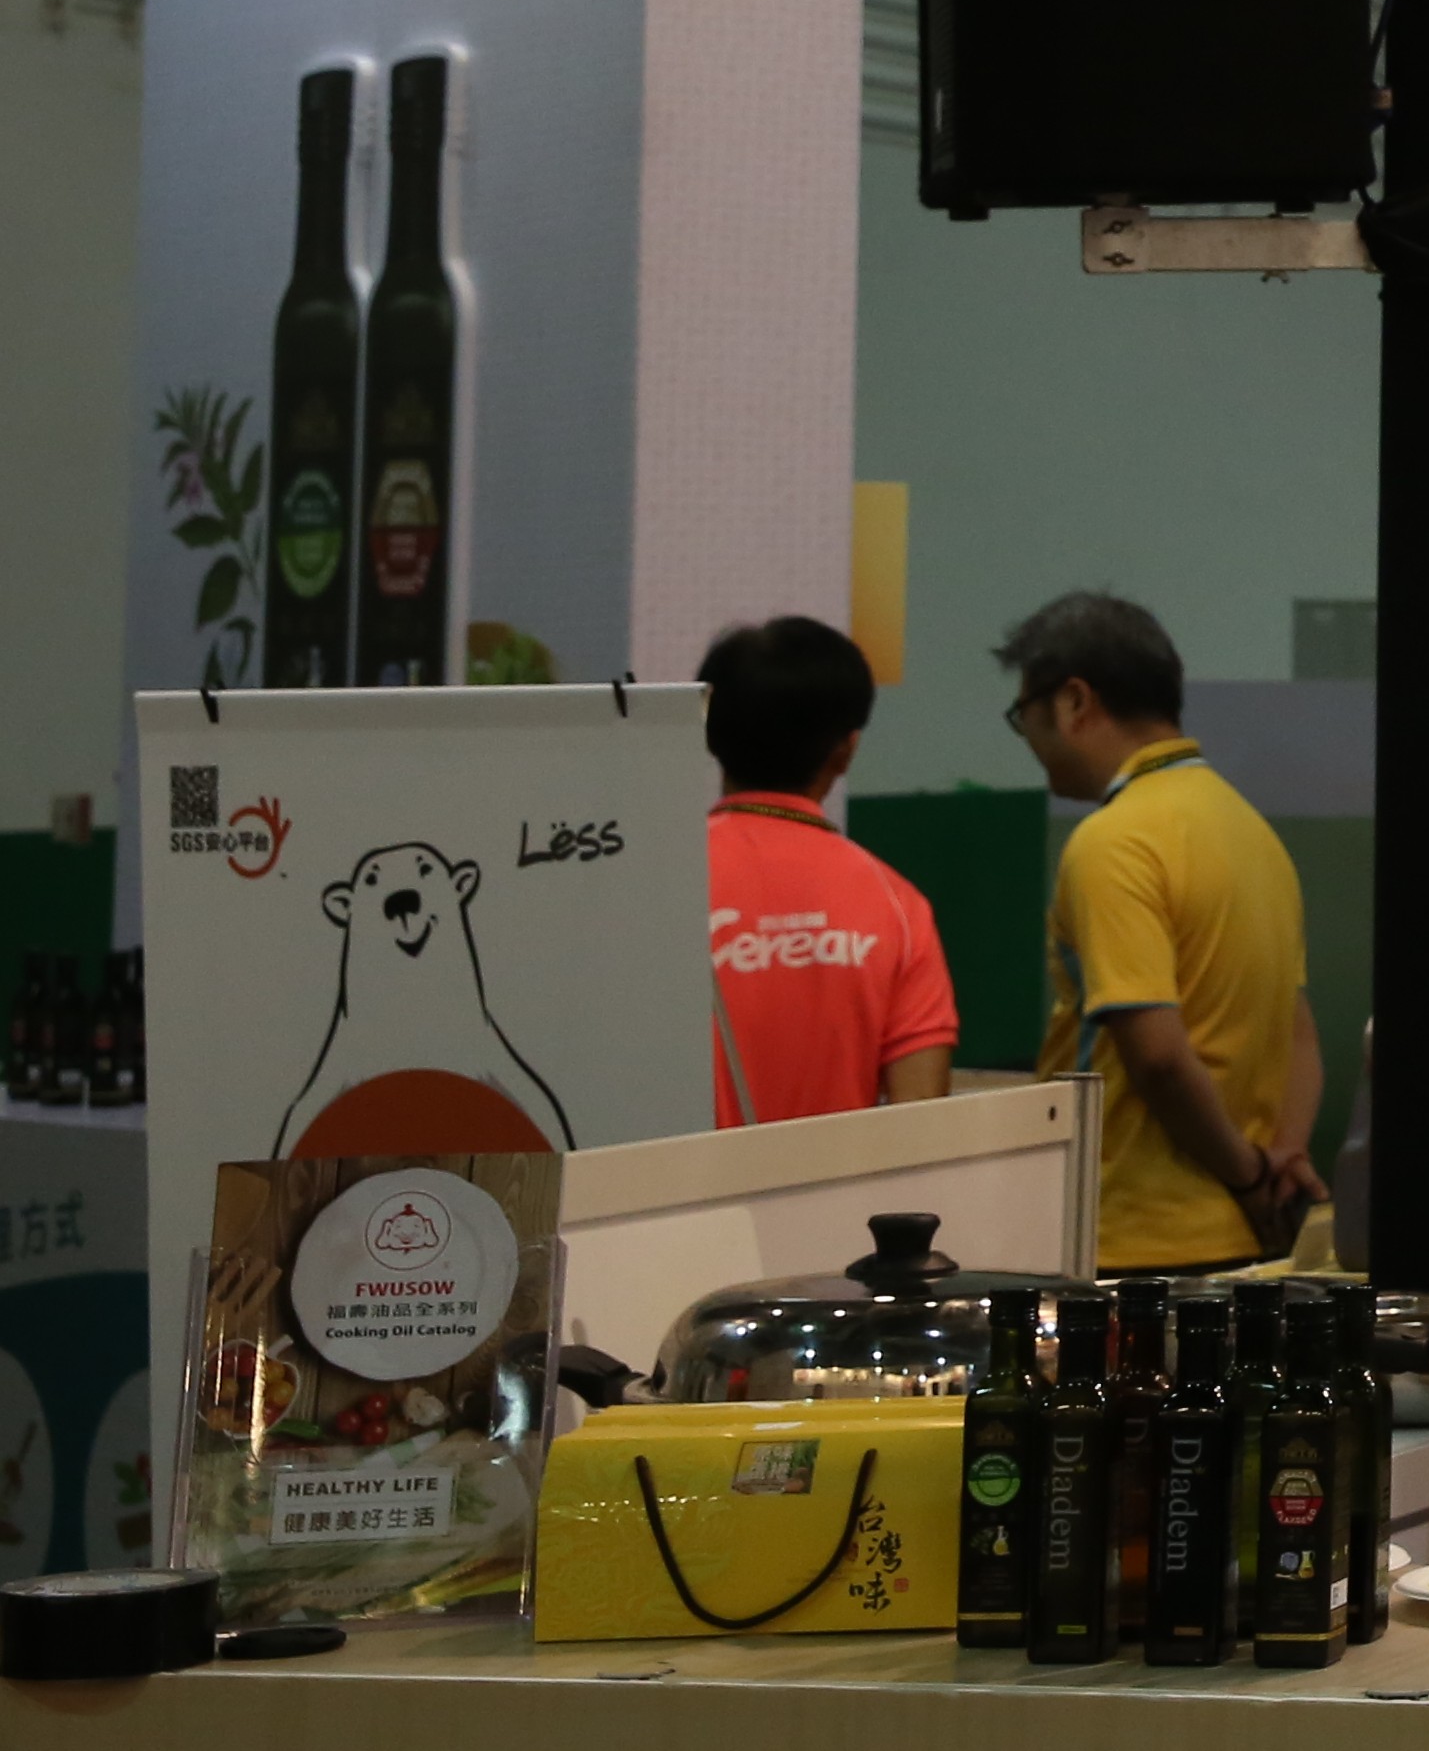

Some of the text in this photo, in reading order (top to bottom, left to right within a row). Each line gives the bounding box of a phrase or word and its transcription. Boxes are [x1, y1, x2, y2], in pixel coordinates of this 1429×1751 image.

[169, 832, 270, 853] SGS安心平台
[354, 1279, 456, 1299] FWUSOW
[326, 1300, 479, 1320] 福壽油品全系列
[324, 1322, 477, 1340] Cooking Oil Catalog
[285, 1476, 440, 1499] HEALTHY LIFE
[1048, 1435, 1090, 1572] Diadem
[1166, 1437, 1207, 1574] Diadem
[283, 1507, 436, 1535] 健康美好生活
